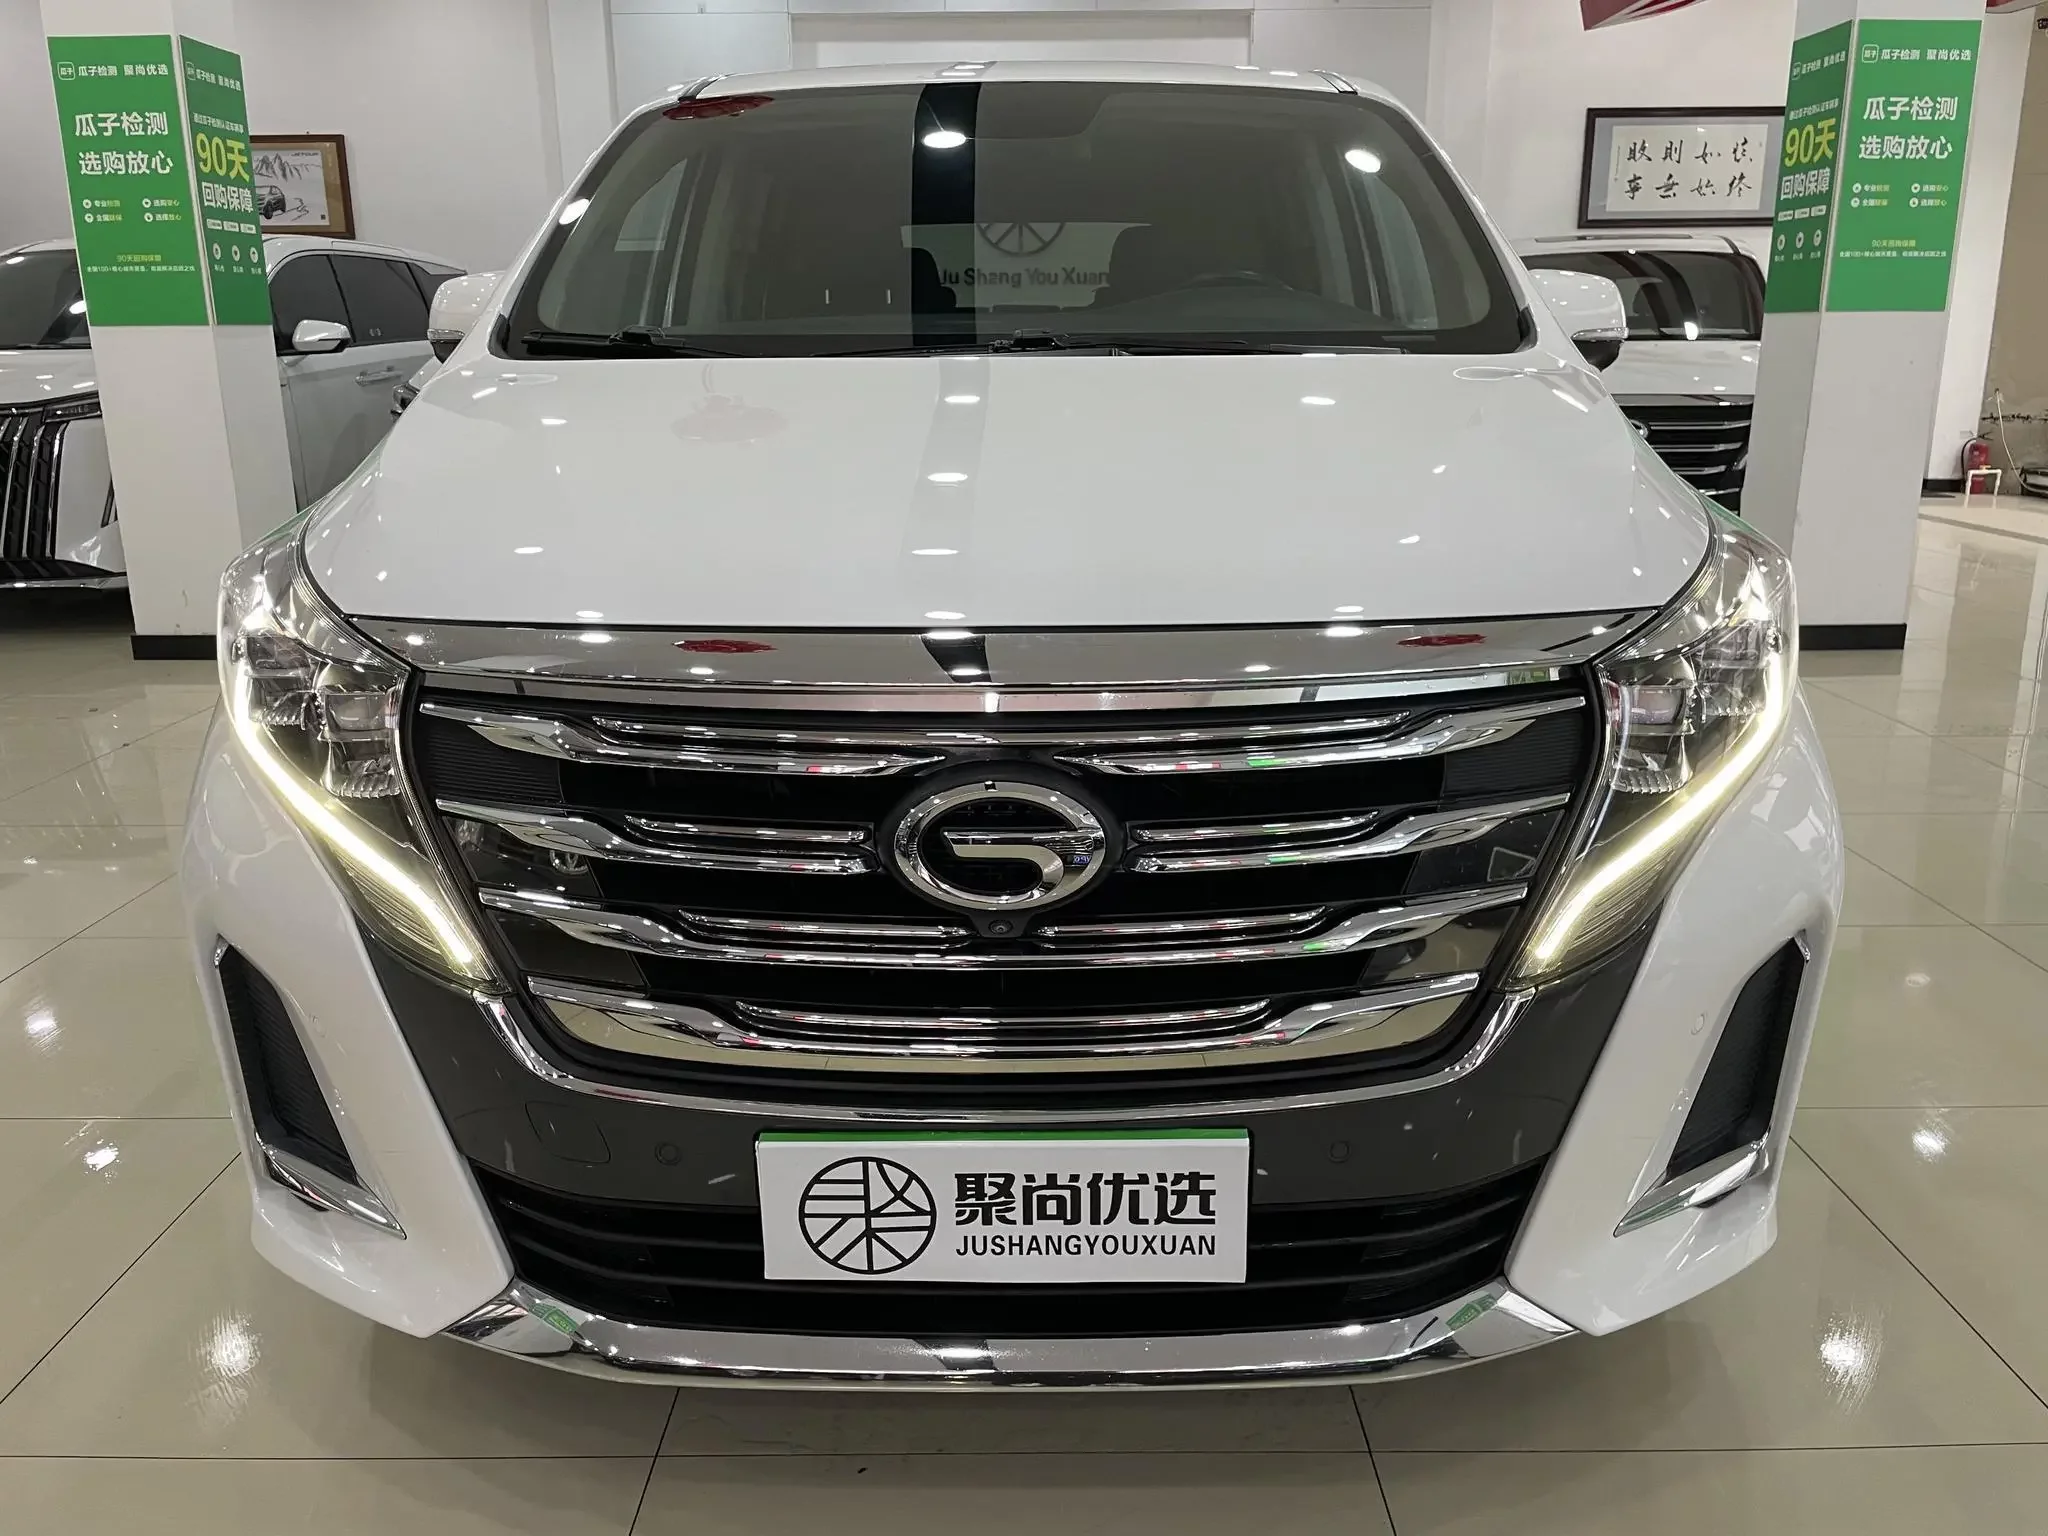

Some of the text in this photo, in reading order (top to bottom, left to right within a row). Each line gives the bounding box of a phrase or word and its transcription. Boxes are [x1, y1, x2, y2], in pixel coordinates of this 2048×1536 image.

[1880, 48, 1921, 61] 瓜子检测
[1926, 48, 1972, 61] 聚尚优选
[78, 65, 118, 76] 瓜子检测
[123, 63, 169, 76] 聚尚优选
[1863, 95, 1958, 122] 瓜子检测
[75, 111, 169, 138] 瓜子检测
[1784, 117, 1837, 169] 90天
[1858, 134, 1953, 161] 选购放心
[78, 150, 174, 176] 选购放心
[195, 131, 251, 183] 90天
[1780, 165, 1831, 201] 回购保障
[202, 180, 254, 214] 回购保障
[963, 267, 1022, 288] Shang
[1024, 267, 1059, 285] You
[1061, 266, 1110, 285] Xuan
[954, 1171, 1217, 1227] 聚尚优选
[955, 1234, 1216, 1257] JUSHANGYOUXUAN
